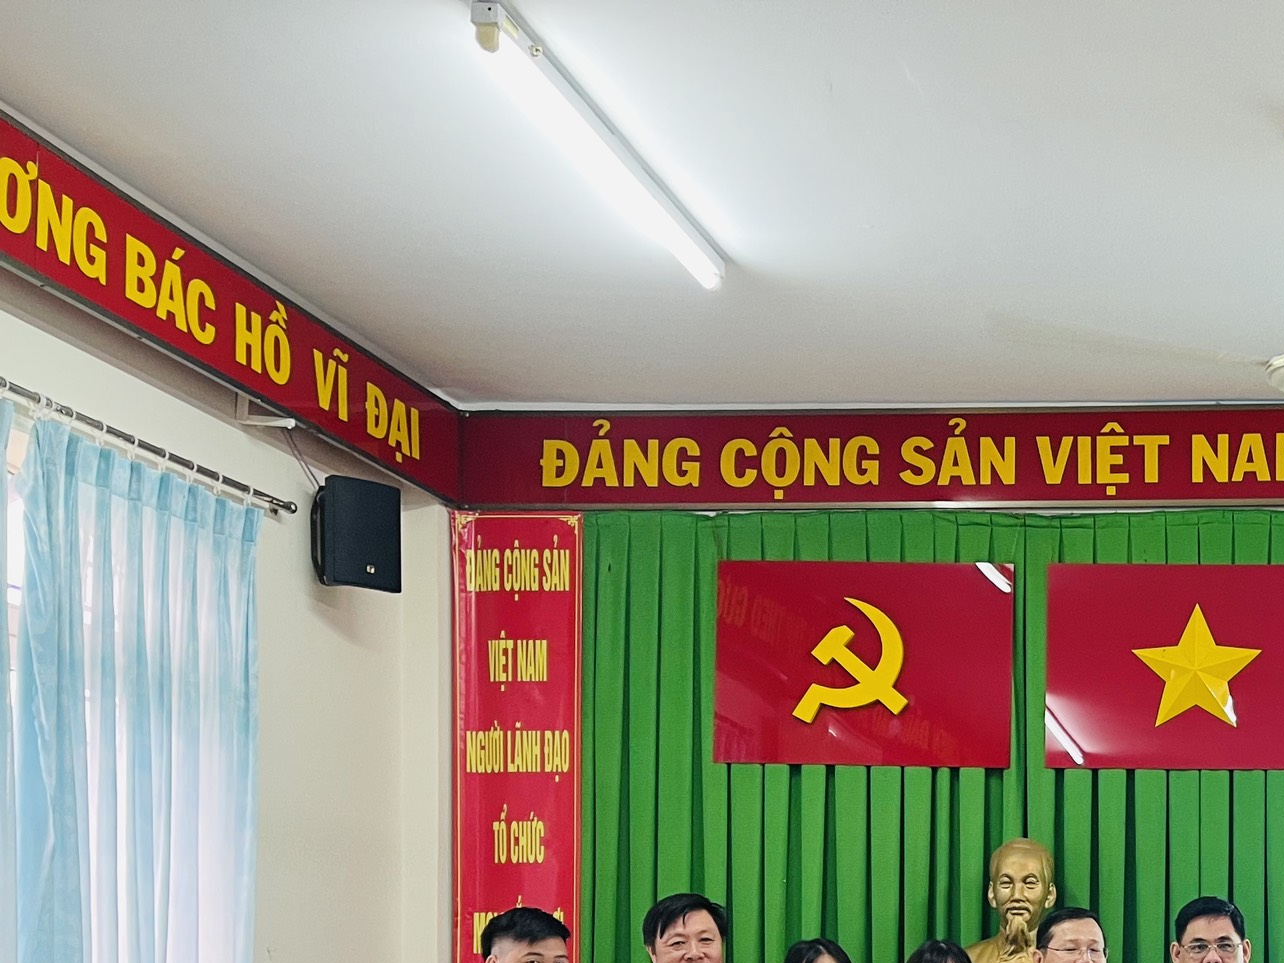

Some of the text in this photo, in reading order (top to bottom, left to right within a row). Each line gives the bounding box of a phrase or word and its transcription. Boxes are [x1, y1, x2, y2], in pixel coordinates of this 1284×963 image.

[125, 232, 216, 345] BÁC
[235, 300, 291, 385] HỒ
[313, 347, 349, 422] VĨ
[365, 381, 420, 463] ĐẠI
[540, 419, 700, 487] ĐẢNG
[720, 426, 880, 499] CỘNG
[899, 417, 1016, 485] SẢN
[1037, 422, 1169, 495] VIỆT
[466, 535, 570, 601] ĐẢNG CỘNG SẢN
[488, 630, 548, 692] VIỆT NAM
[466, 720, 570, 783] NGƯỜI LÃNH ĐẠO
[492, 803, 545, 864] TỔ CHỨC
